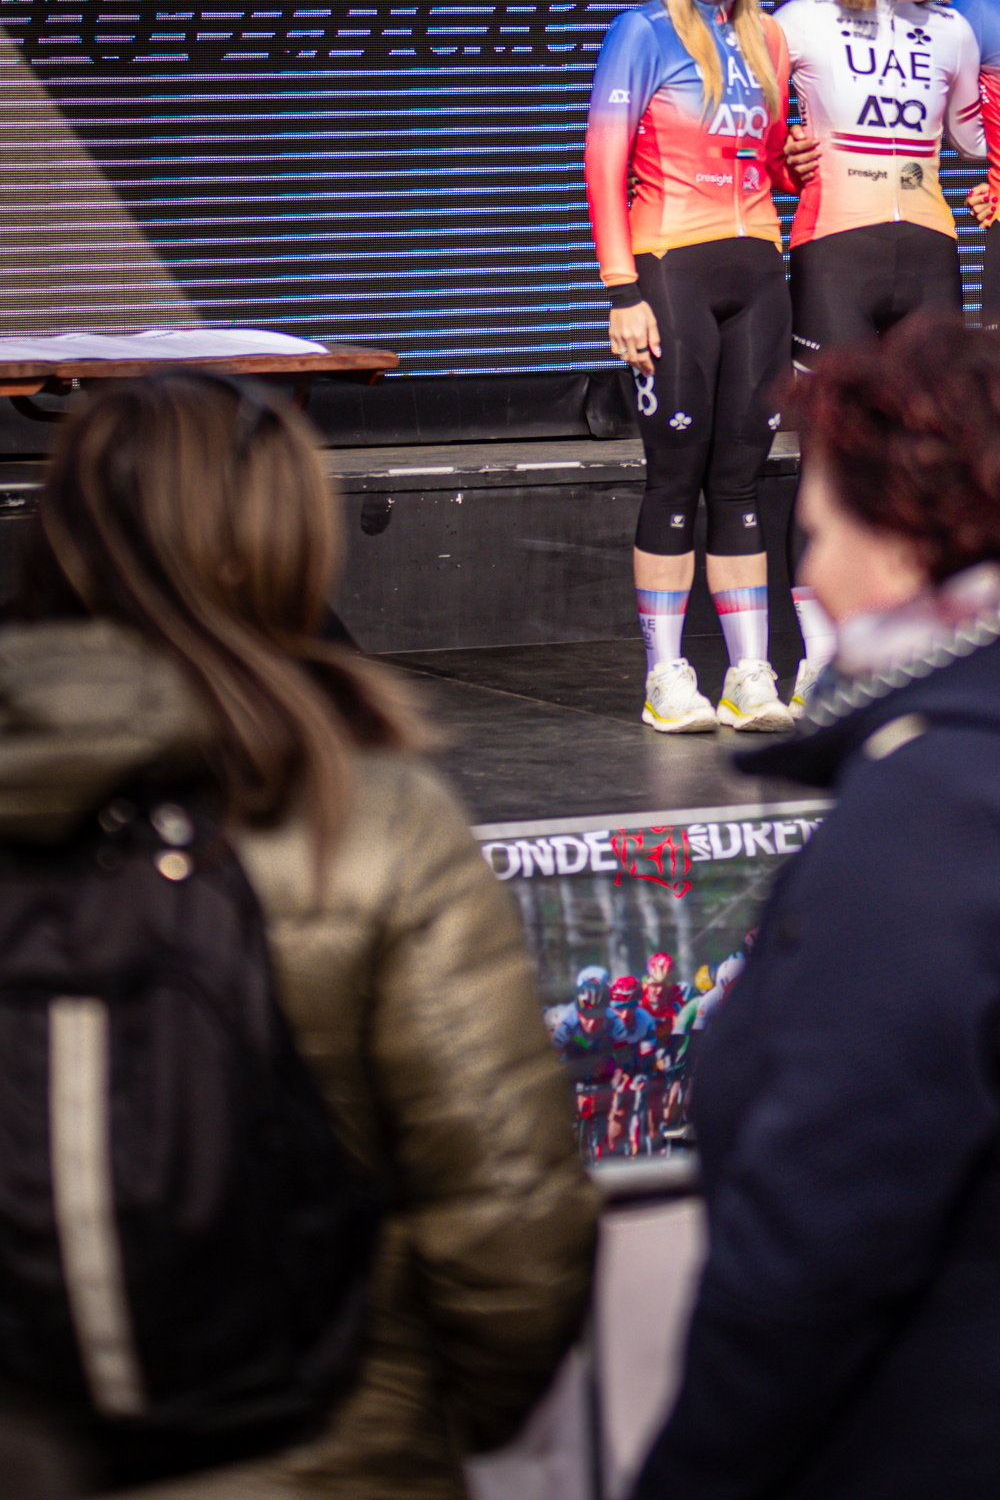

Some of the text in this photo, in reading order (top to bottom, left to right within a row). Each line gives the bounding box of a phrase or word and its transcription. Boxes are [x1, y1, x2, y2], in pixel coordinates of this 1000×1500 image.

[845, 44, 932, 82] UAE
[852, 74, 931, 91] TEAM
[708, 103, 769, 139] ADQ
[857, 95, 928, 132] ADQ
[695, 172, 734, 187] presight
[848, 168, 889, 181] presight
[482, 830, 618, 881] ONDE
